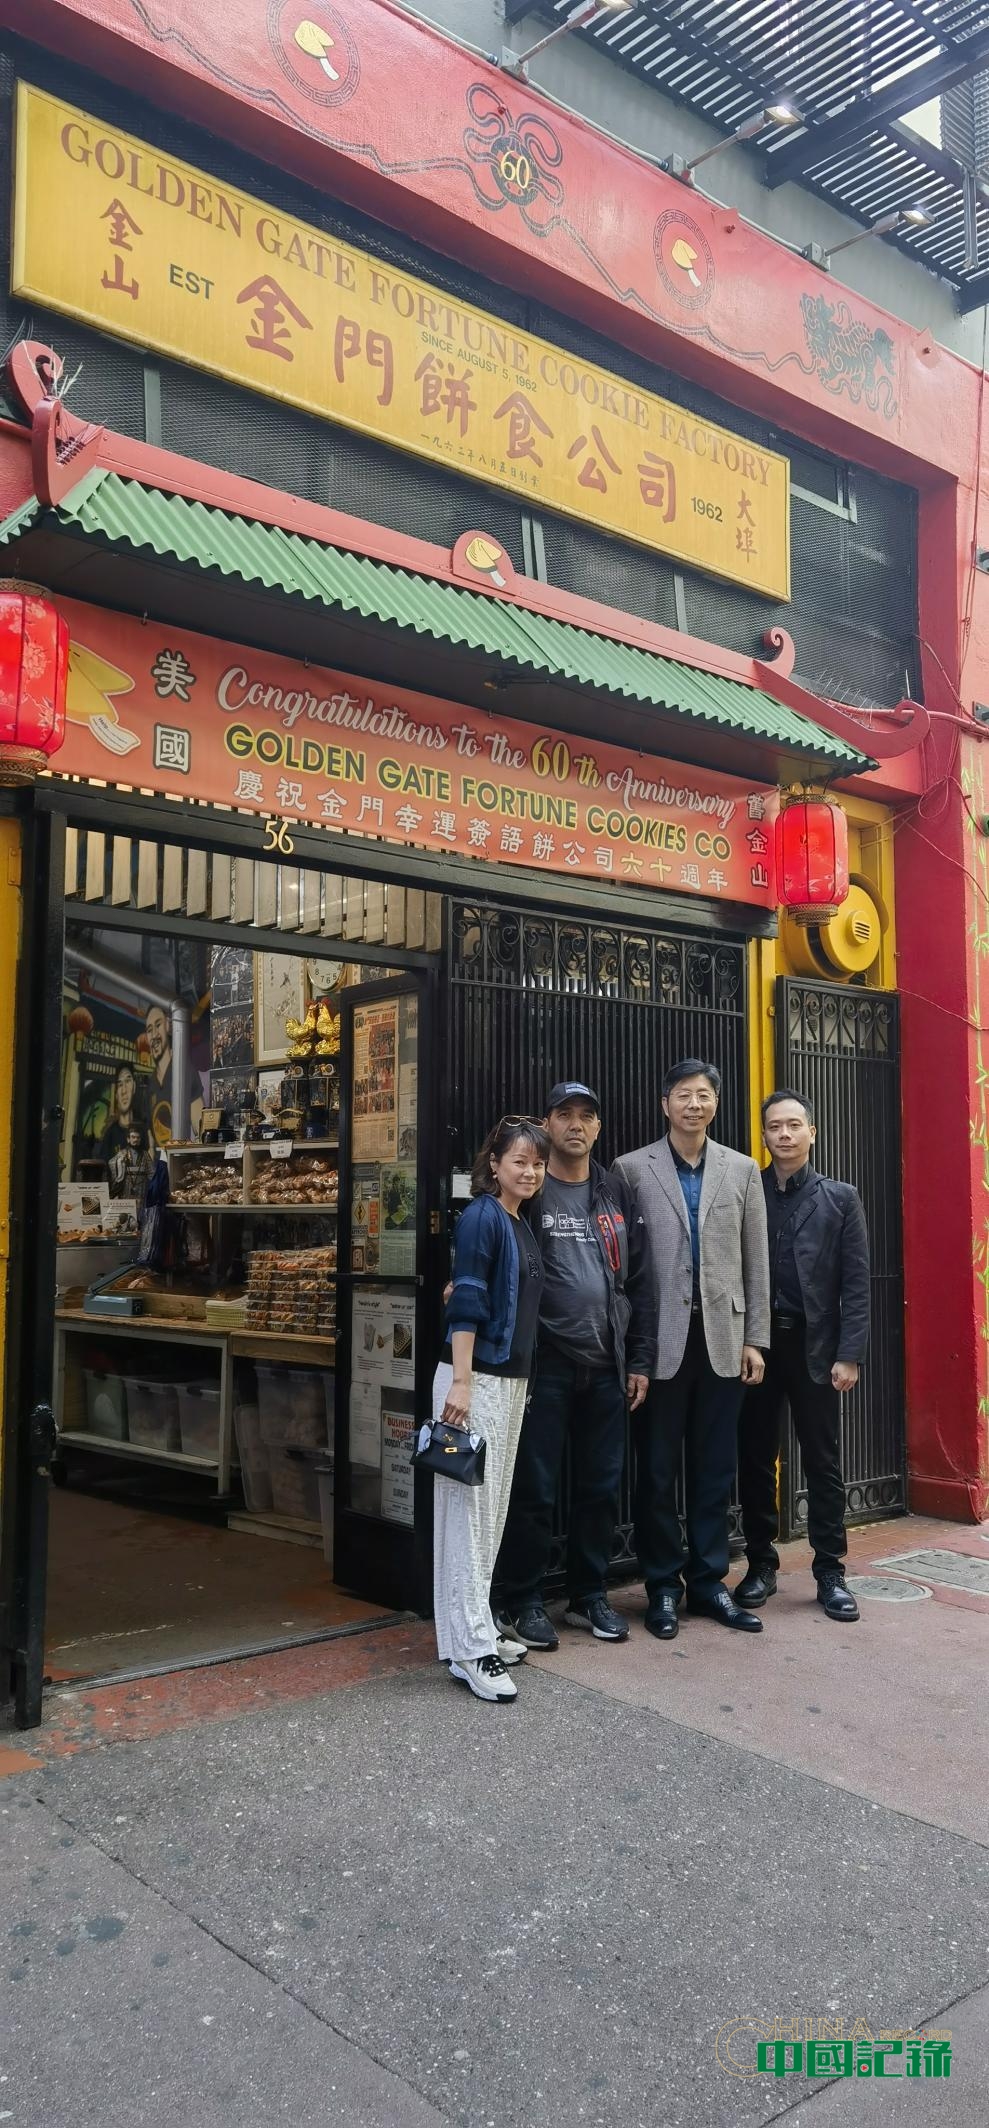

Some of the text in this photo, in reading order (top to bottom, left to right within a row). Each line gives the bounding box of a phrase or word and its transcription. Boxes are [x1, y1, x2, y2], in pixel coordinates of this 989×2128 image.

[502, 151, 529, 188] 60
[100, 198, 143, 300] 金山
[169, 263, 215, 300] EST
[61, 123, 772, 488] GOLDEN GATE FORTUNE COOKIE FACTORY
[236, 274, 677, 523] 金門餅食公司
[421, 331, 453, 354] SINCE
[457, 348, 498, 374] AUGUST
[515, 374, 537, 393] 1962
[691, 496, 723, 523] 1962
[735, 488, 758, 563] 大埠
[152, 648, 195, 775] 美國
[218, 667, 737, 830] Congratulations to the 60 th Anniversary
[225, 724, 731, 861] GOLDEN GATE FORTUNE COOKIES CO
[263, 820, 294, 855] 56
[747, 793, 769, 889] 舊金山
[387, 1417, 415, 1429] BUSINESS
